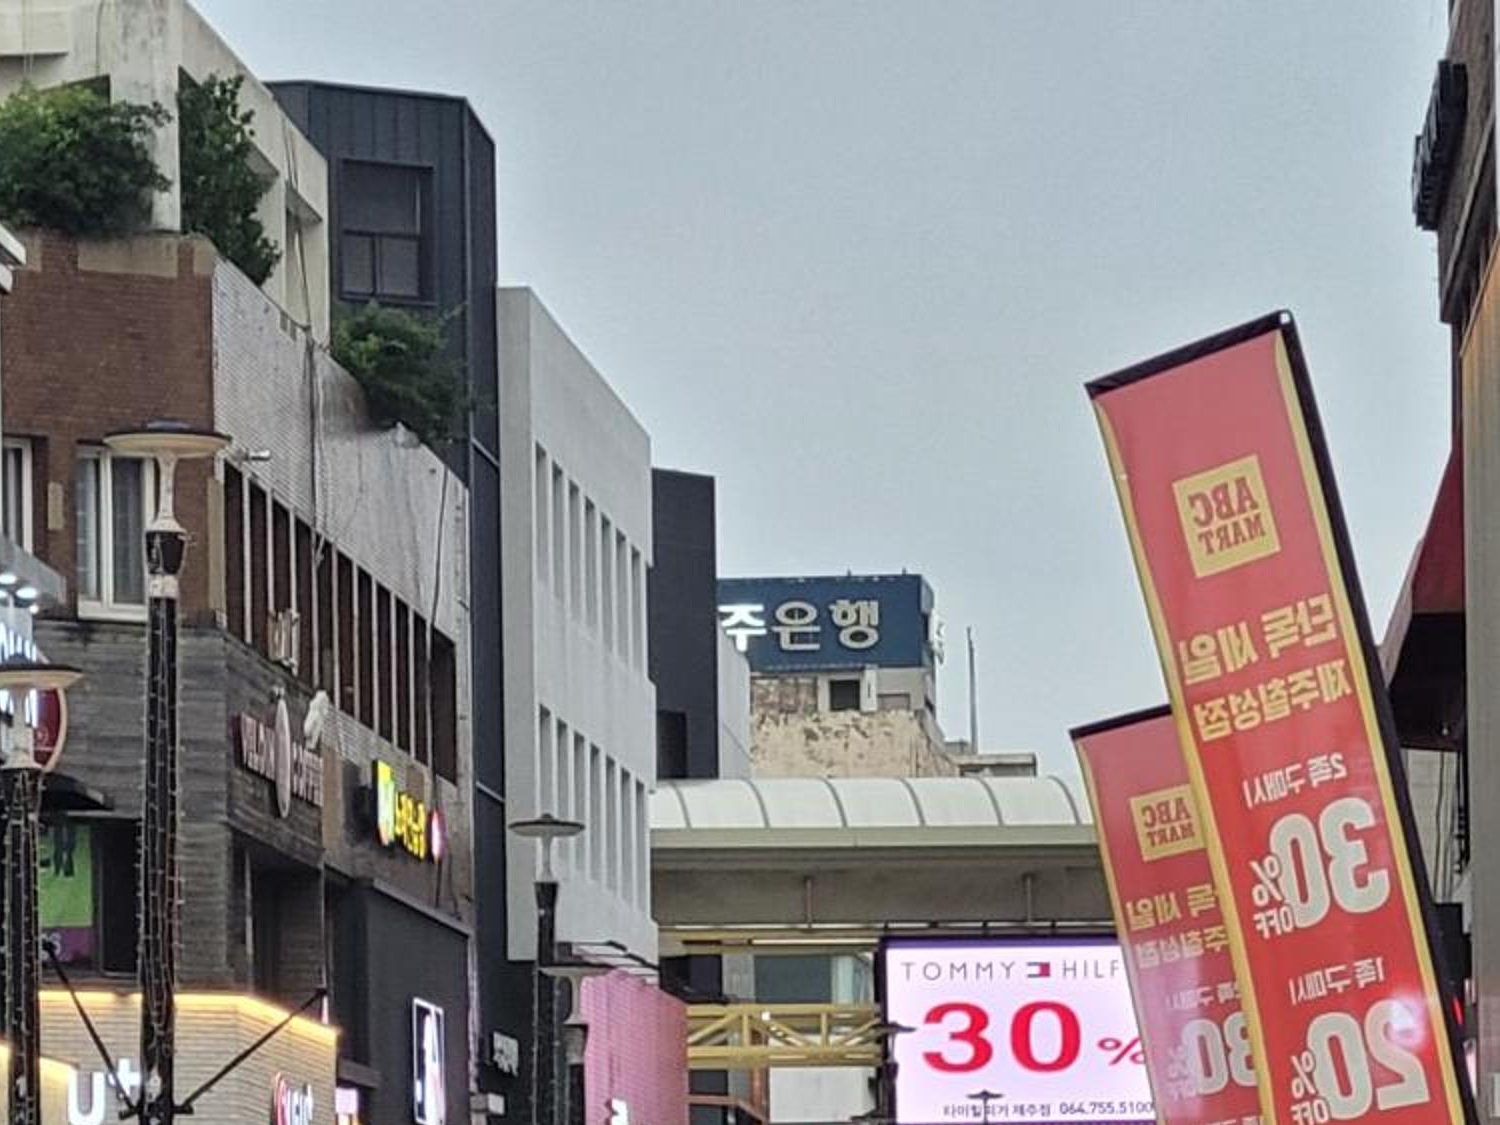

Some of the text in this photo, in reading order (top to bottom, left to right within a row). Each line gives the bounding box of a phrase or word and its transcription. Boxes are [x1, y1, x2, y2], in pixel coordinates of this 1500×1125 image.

[717, 599, 880, 653] 주은행
[901, 961, 1016, 982] TOMMY
[1012, 1103, 1052, 1117] 제주점
[1059, 1101, 1154, 1116] 064.755.5100
